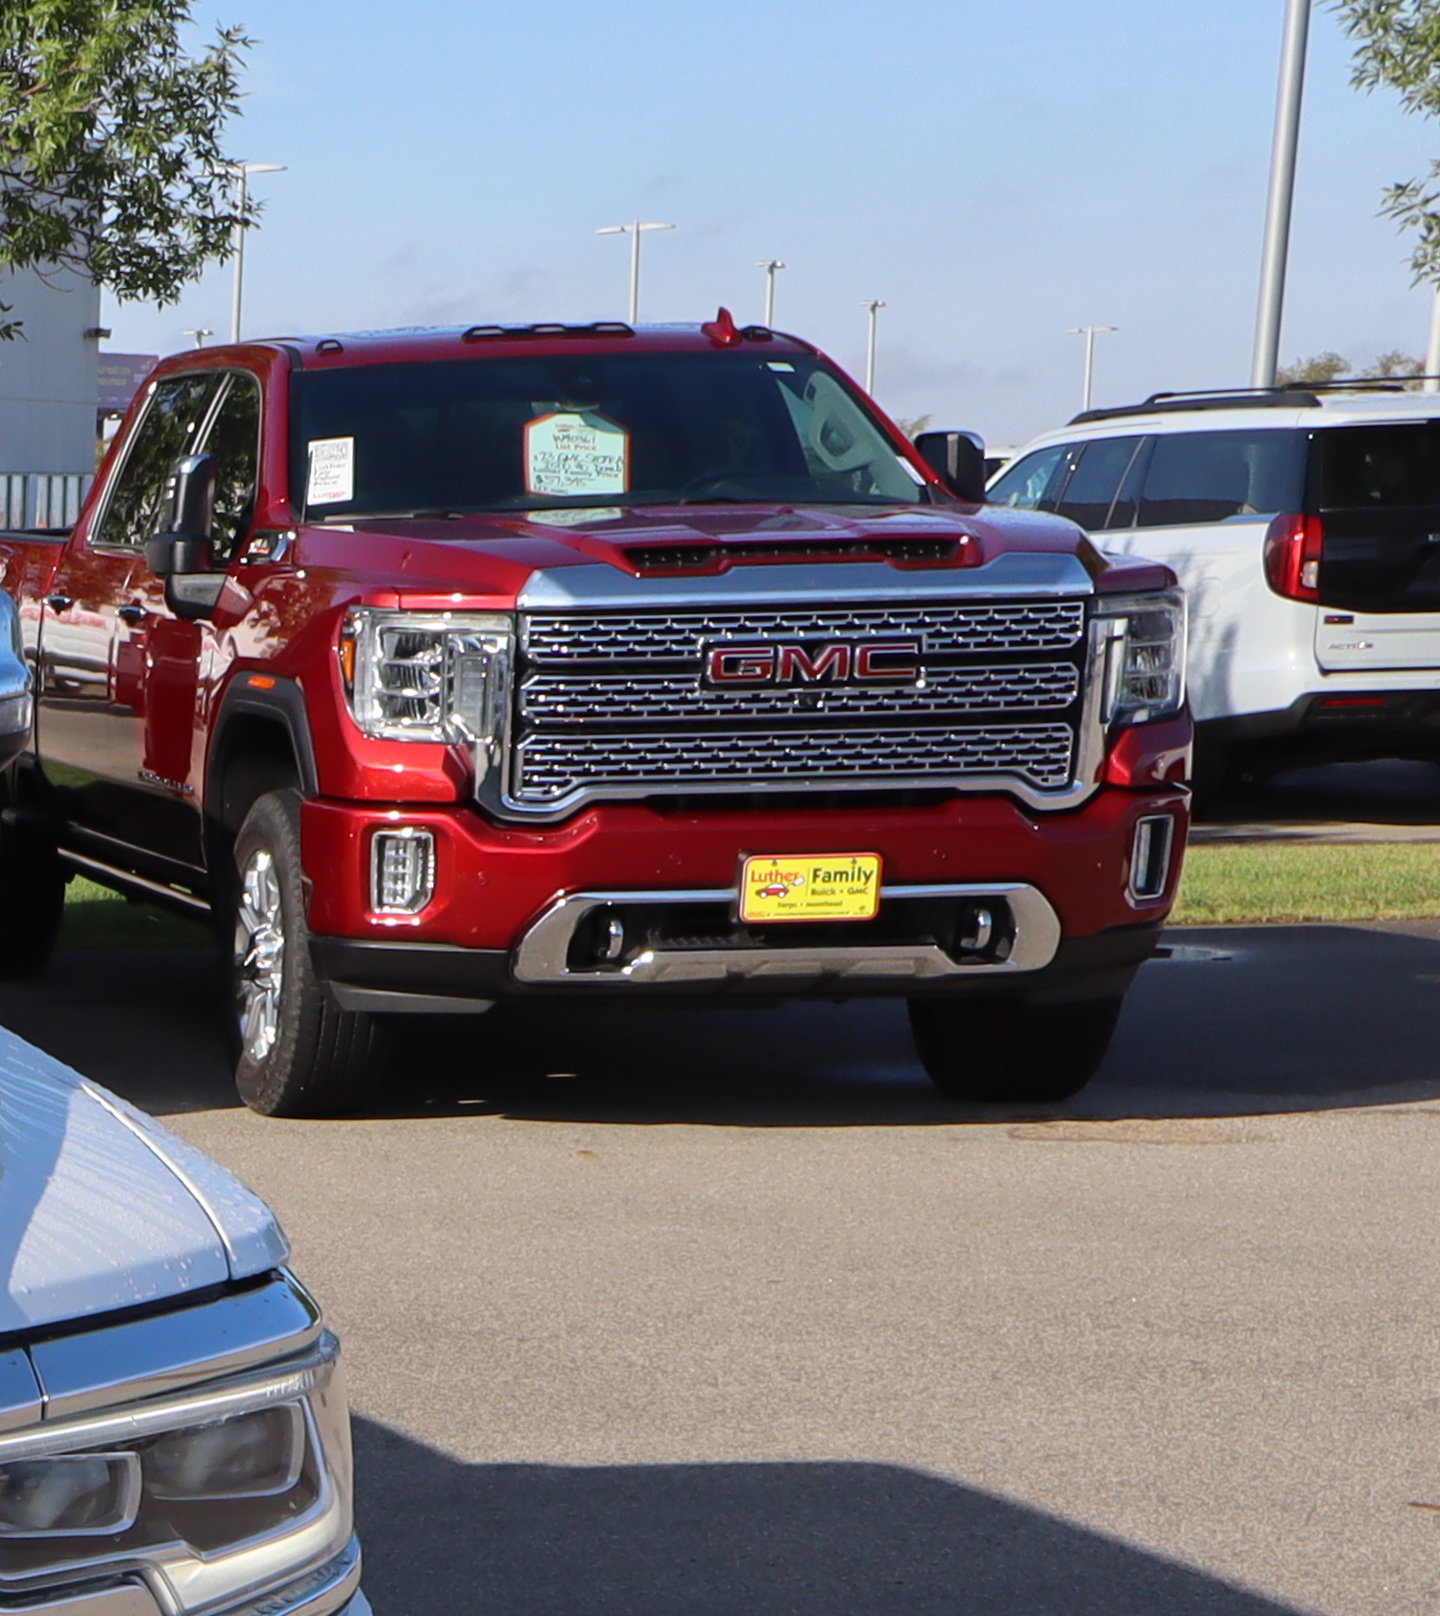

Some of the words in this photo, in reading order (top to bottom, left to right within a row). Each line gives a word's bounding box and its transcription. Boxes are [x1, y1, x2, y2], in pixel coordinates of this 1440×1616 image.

[708, 643, 918, 683] GMC
[751, 869, 799, 883] Luther
[812, 866, 873, 885] Family
